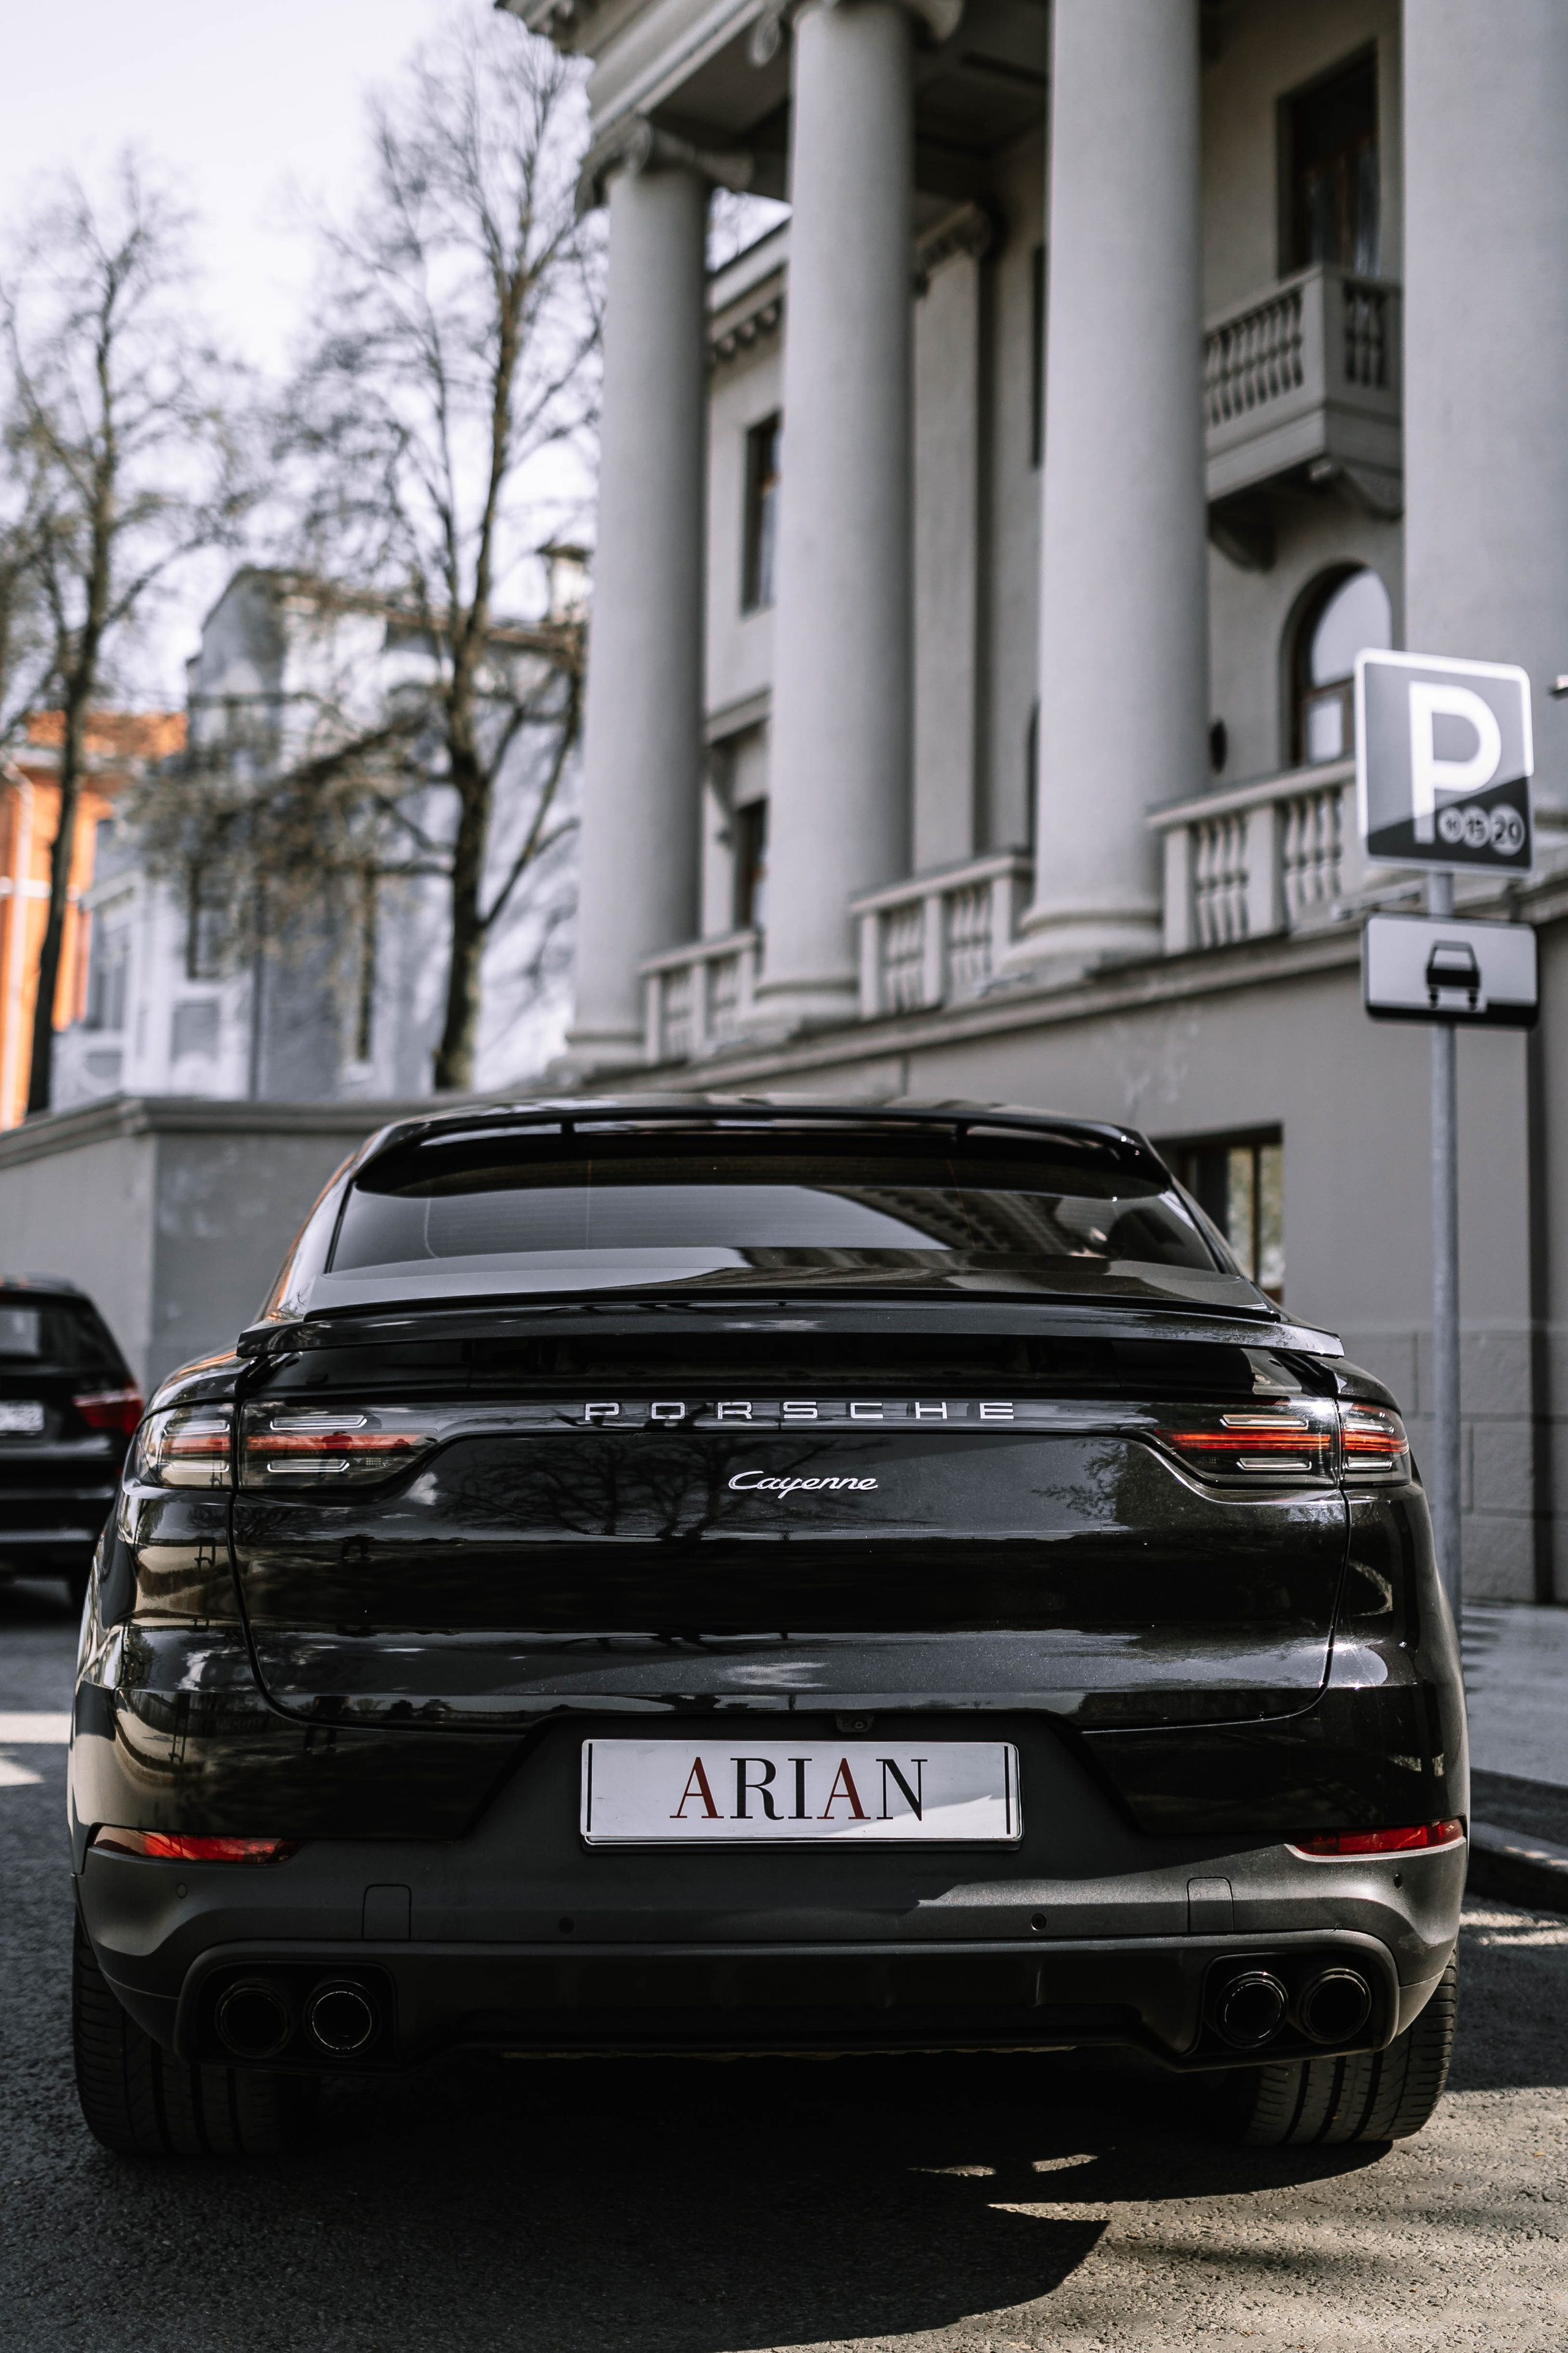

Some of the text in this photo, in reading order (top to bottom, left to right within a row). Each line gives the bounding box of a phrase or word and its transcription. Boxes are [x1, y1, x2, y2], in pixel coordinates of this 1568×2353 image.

[1410, 681, 1501, 844] P
[1493, 814, 1522, 845] 20
[584, 1401, 1015, 1421] PORSCHE
[728, 1470, 878, 1499] Cayenne
[669, 1756, 928, 1821] ARIAN
